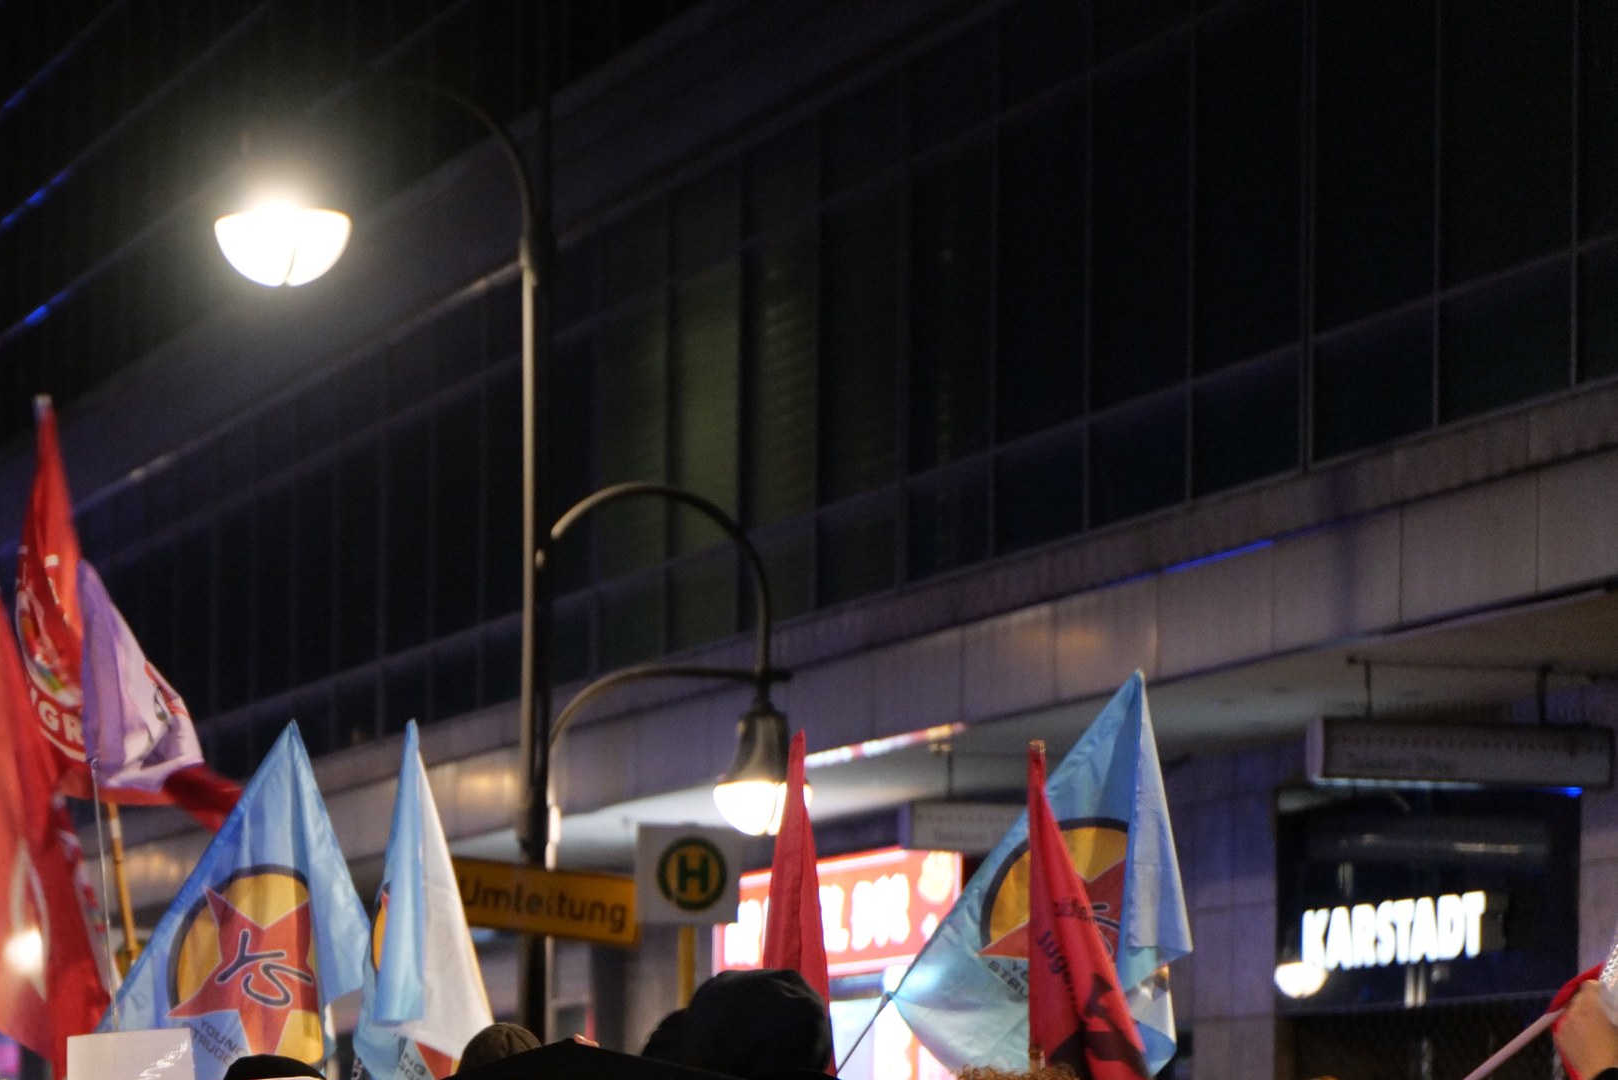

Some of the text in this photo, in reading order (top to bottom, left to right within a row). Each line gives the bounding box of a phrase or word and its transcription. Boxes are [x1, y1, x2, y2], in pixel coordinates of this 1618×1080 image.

[460, 876, 627, 934] Umleitung
[1301, 889, 1487, 970] KARSTADT
[215, 928, 314, 1007] YS
